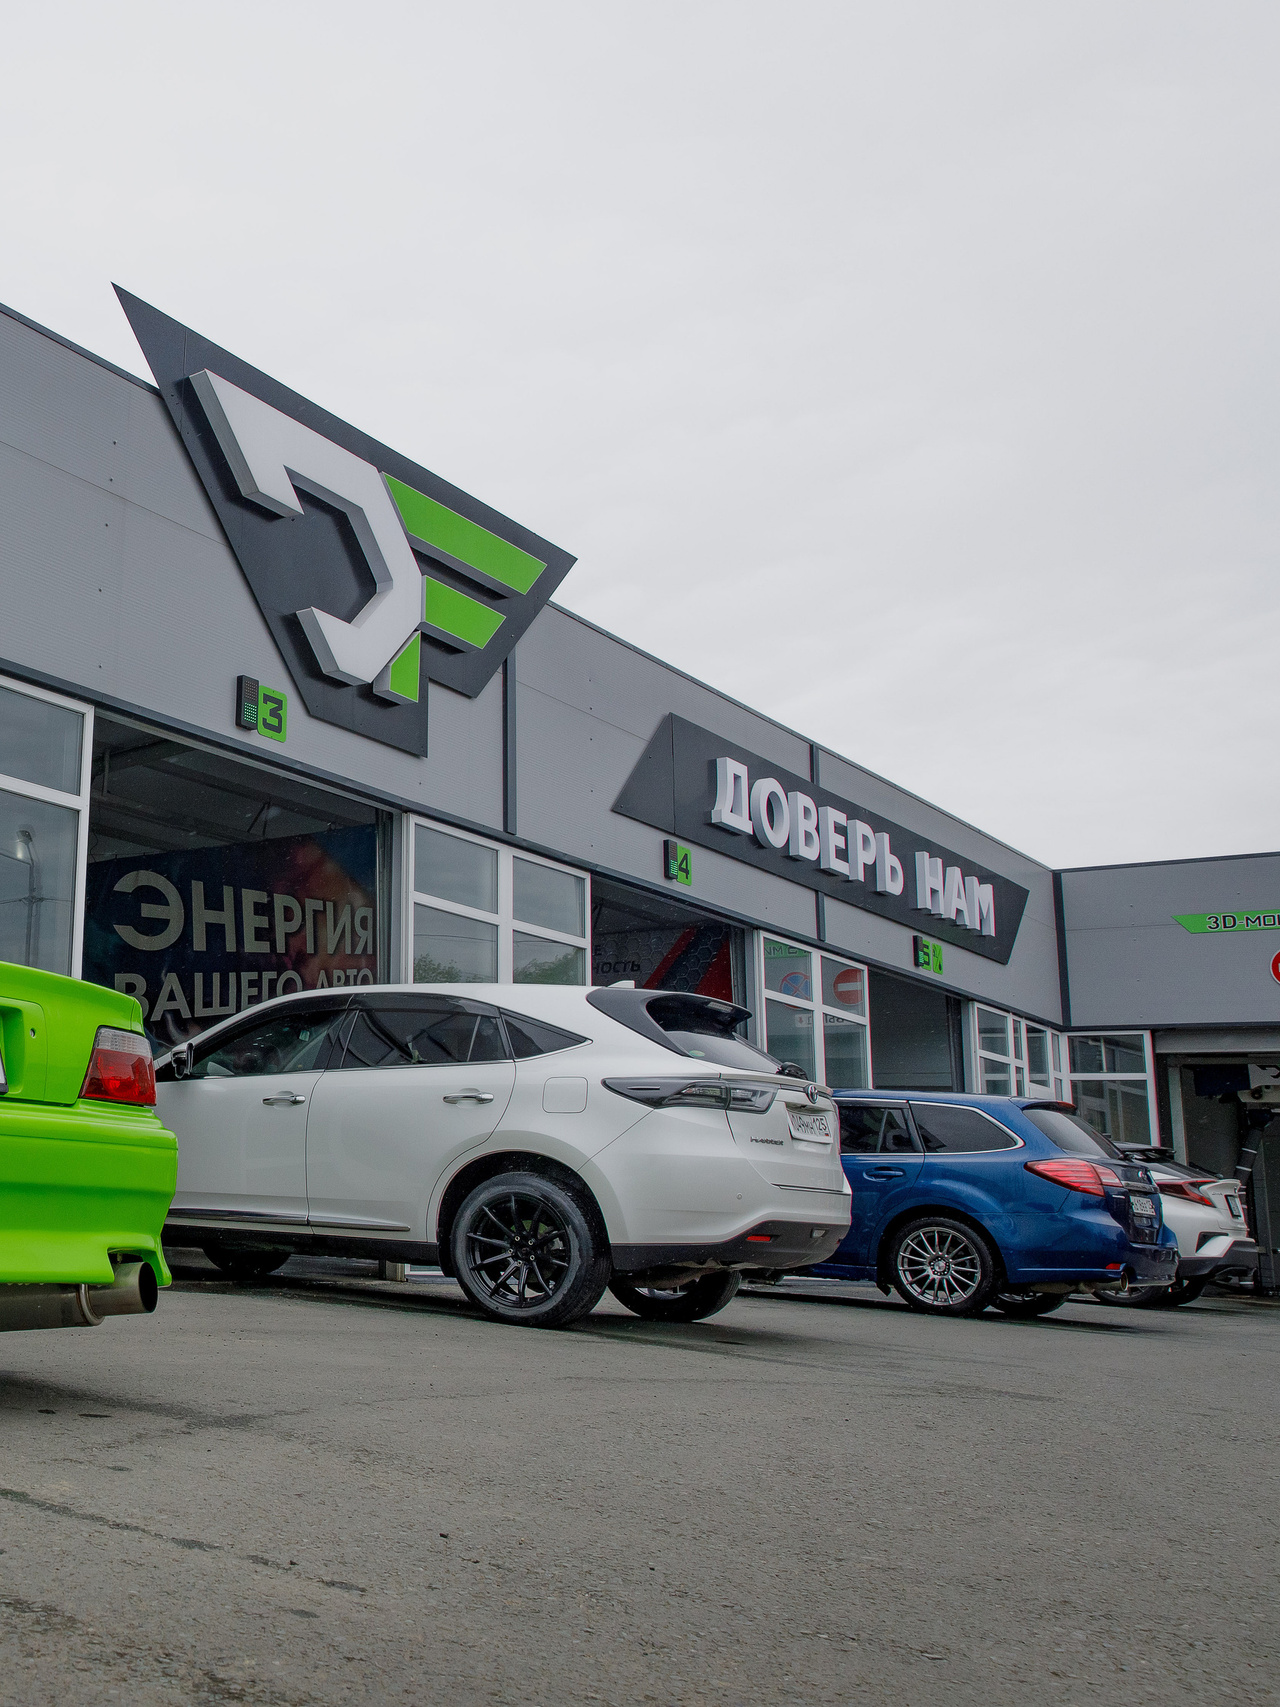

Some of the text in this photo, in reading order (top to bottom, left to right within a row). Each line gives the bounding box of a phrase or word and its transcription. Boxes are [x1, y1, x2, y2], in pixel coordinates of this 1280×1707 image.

[261, 693, 284, 735] 3
[678, 852, 690, 880] 4
[711, 756, 996, 937] ДОВЕРЬ НАМ
[113, 869, 373, 955] ЭНЕРГИЯ
[114, 969, 303, 1022] ВАШЕГО
